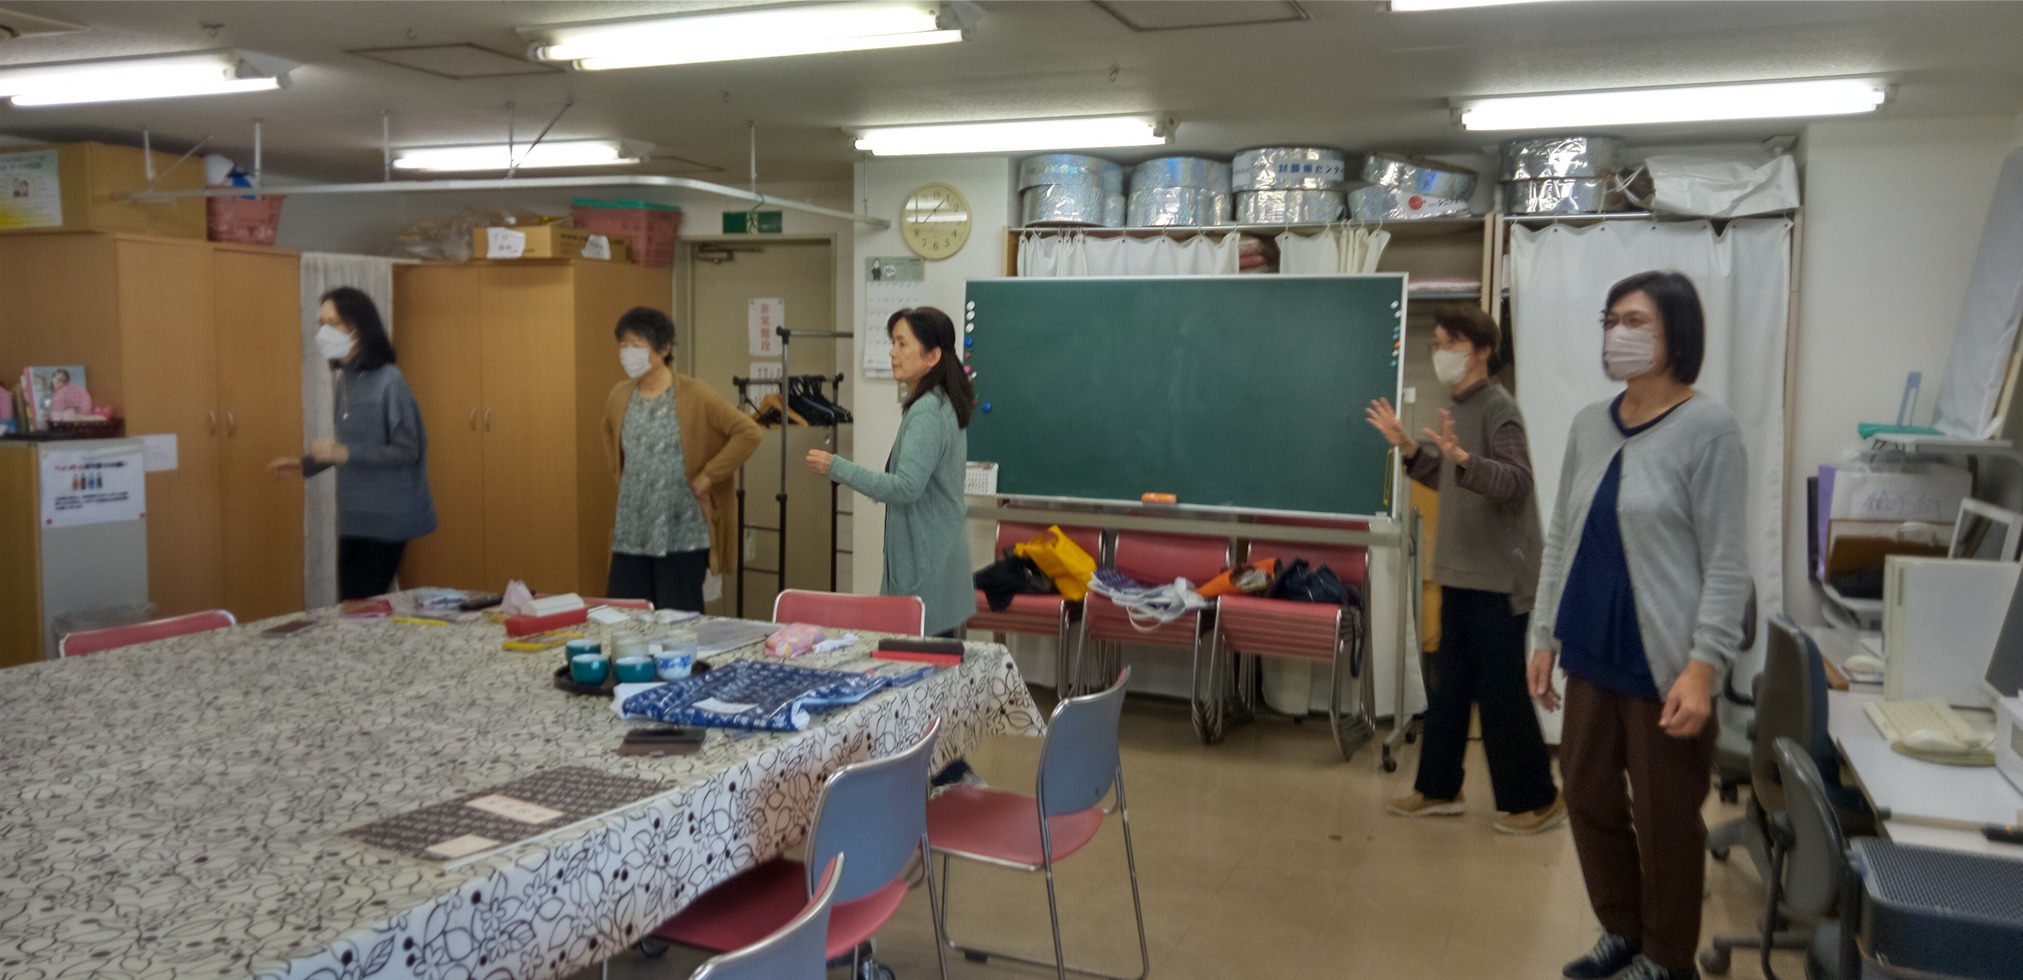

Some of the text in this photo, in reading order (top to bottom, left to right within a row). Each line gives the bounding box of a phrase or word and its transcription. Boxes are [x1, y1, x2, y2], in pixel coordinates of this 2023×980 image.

[953, 204, 959, 212] 2
[914, 230, 920, 238] 8
[952, 229, 957, 238] 4
[922, 239, 928, 247] 7
[933, 242, 939, 250] 6
[945, 239, 950, 248] 5
